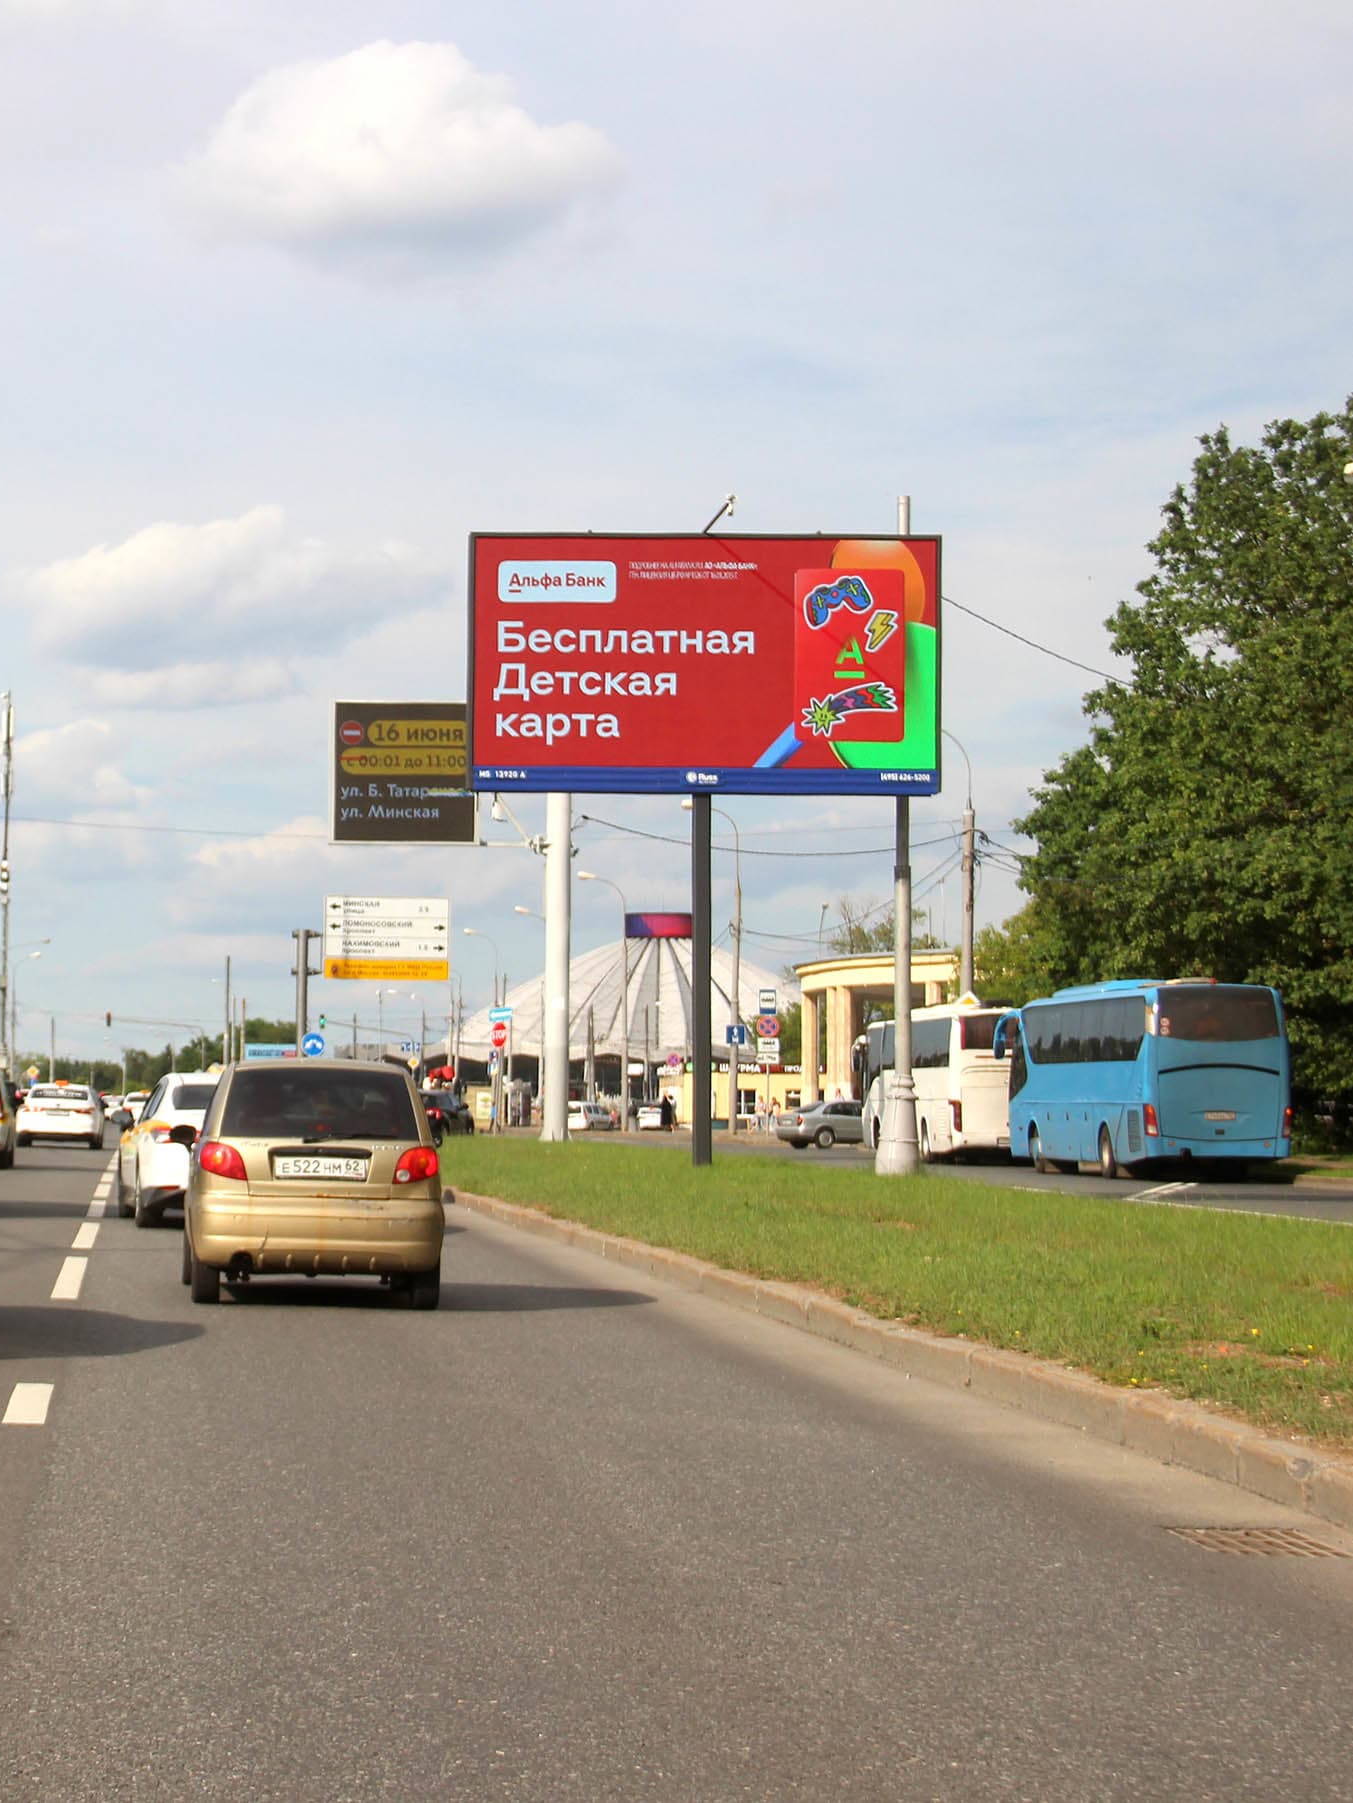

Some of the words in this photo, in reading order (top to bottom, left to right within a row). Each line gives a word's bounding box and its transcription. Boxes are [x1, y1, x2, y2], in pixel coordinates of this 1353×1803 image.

[509, 572, 562, 591] Альфа
[565, 572, 606, 588] Банк
[497, 620, 755, 655] Бесплатная
[493, 662, 678, 701] Детская
[374, 723, 400, 742] 16
[406, 727, 464, 742] июня
[495, 712, 621, 746] карта
[358, 754, 401, 768] 00:01
[403, 757, 423, 769] до
[340, 786, 363, 800] ул.
[367, 783, 383, 797] Б.
[340, 807, 363, 821] ул.
[367, 805, 440, 818] Минская
